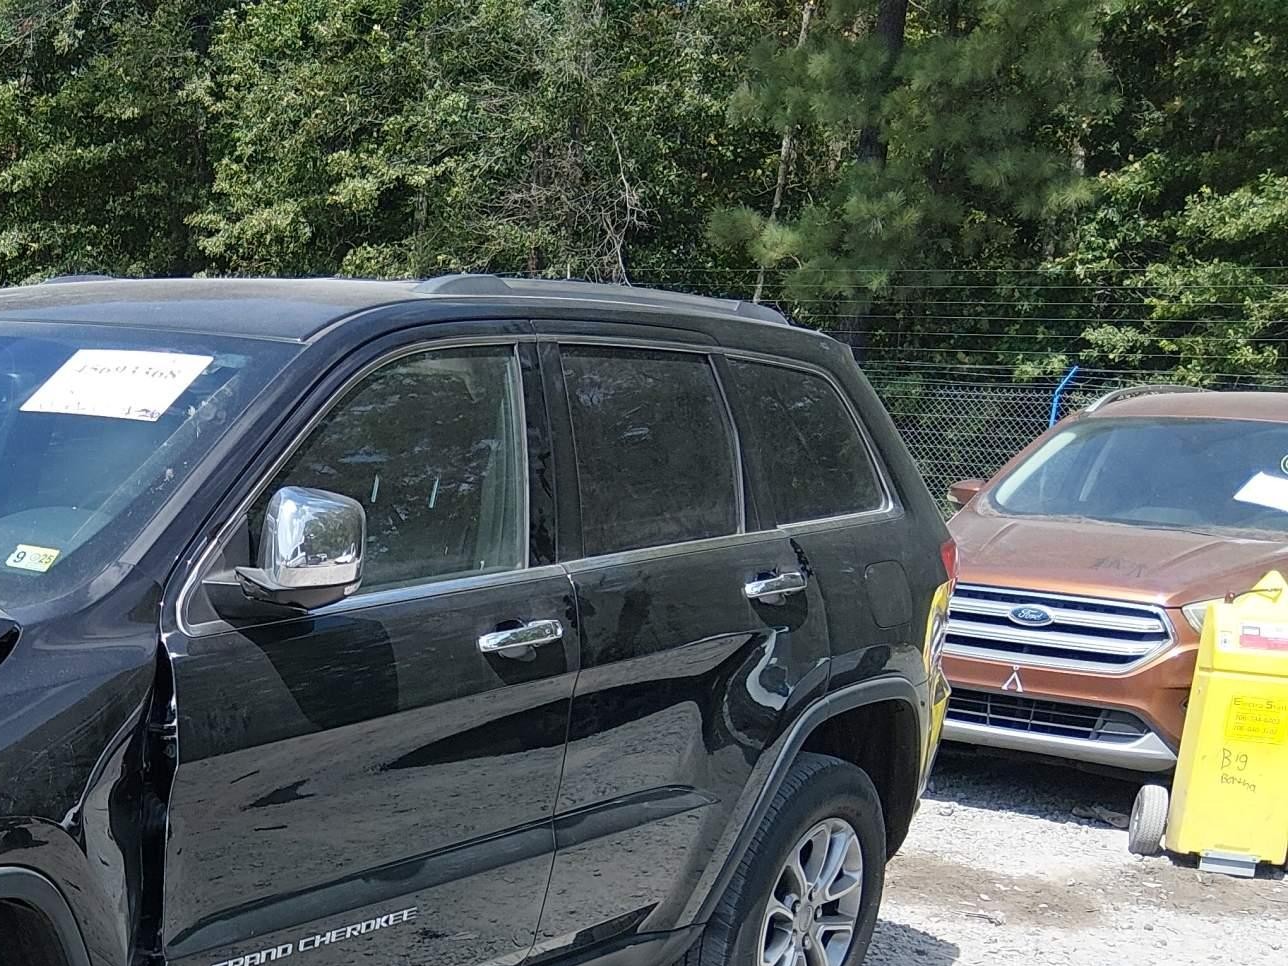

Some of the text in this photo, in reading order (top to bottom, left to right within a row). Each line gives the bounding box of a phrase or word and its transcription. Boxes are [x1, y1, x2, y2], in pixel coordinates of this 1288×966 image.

[13, 551, 55, 564] 9 25
[1016, 608, 1045, 620] Ford
[298, 906, 418, 952] CHEROKEE
